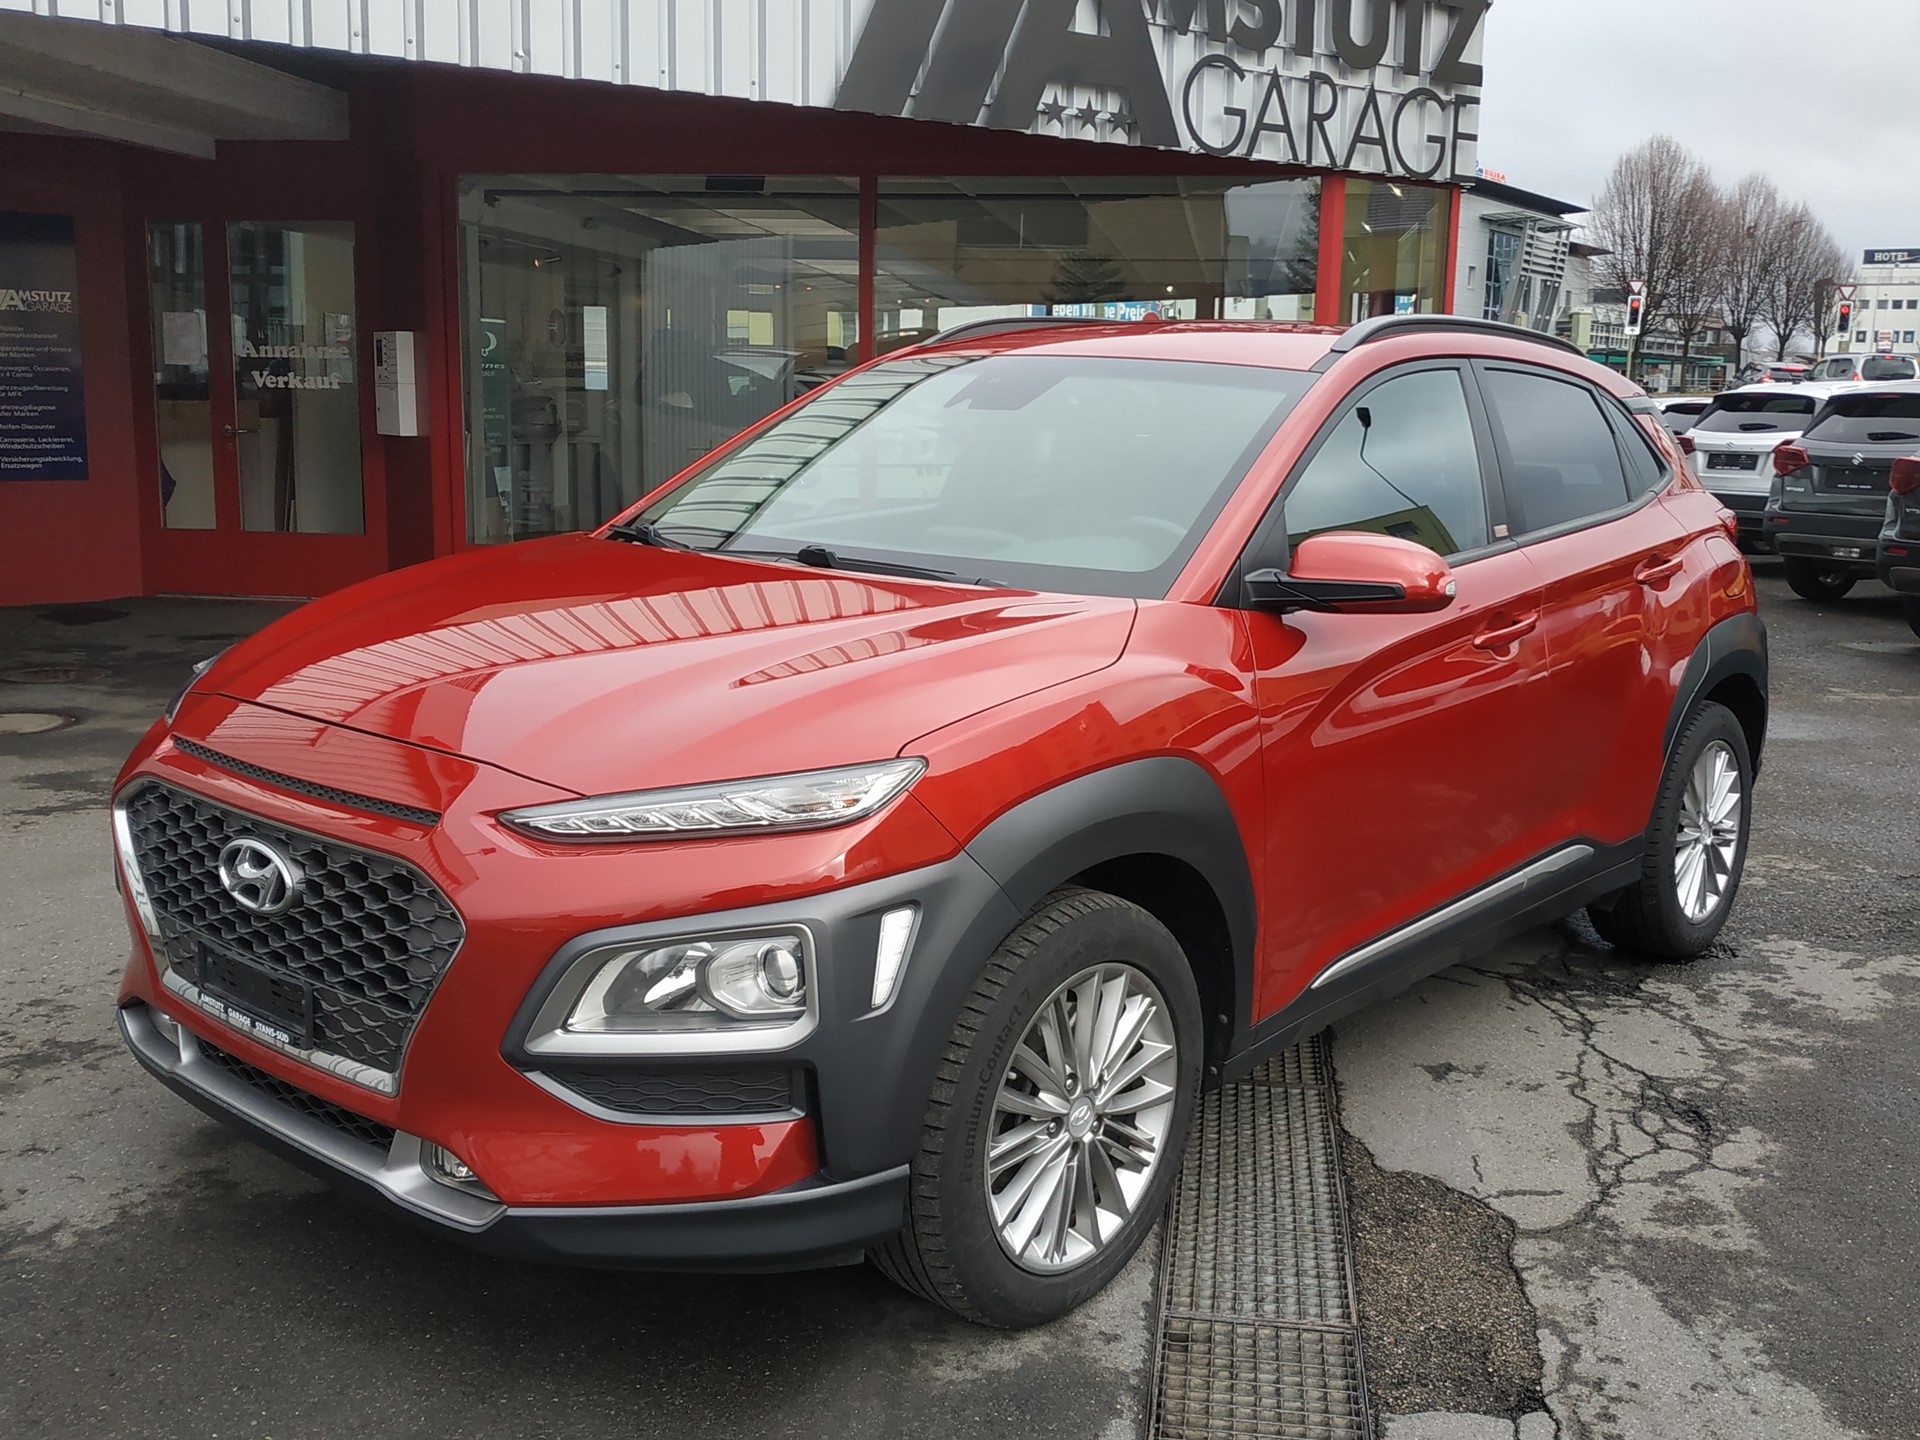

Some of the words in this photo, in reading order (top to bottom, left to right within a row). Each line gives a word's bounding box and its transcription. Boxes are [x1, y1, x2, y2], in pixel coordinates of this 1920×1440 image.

[1182, 54, 1482, 183] GARAGE
[1873, 251, 1908, 262] HOTEL
[3, 289, 72, 311] AMSTUTZ
[25, 301, 72, 313] GARAGE
[251, 370, 341, 390] Verkauf
[200, 993, 225, 1013] AMSTUTZ
[228, 1007, 251, 1027] GARAGE
